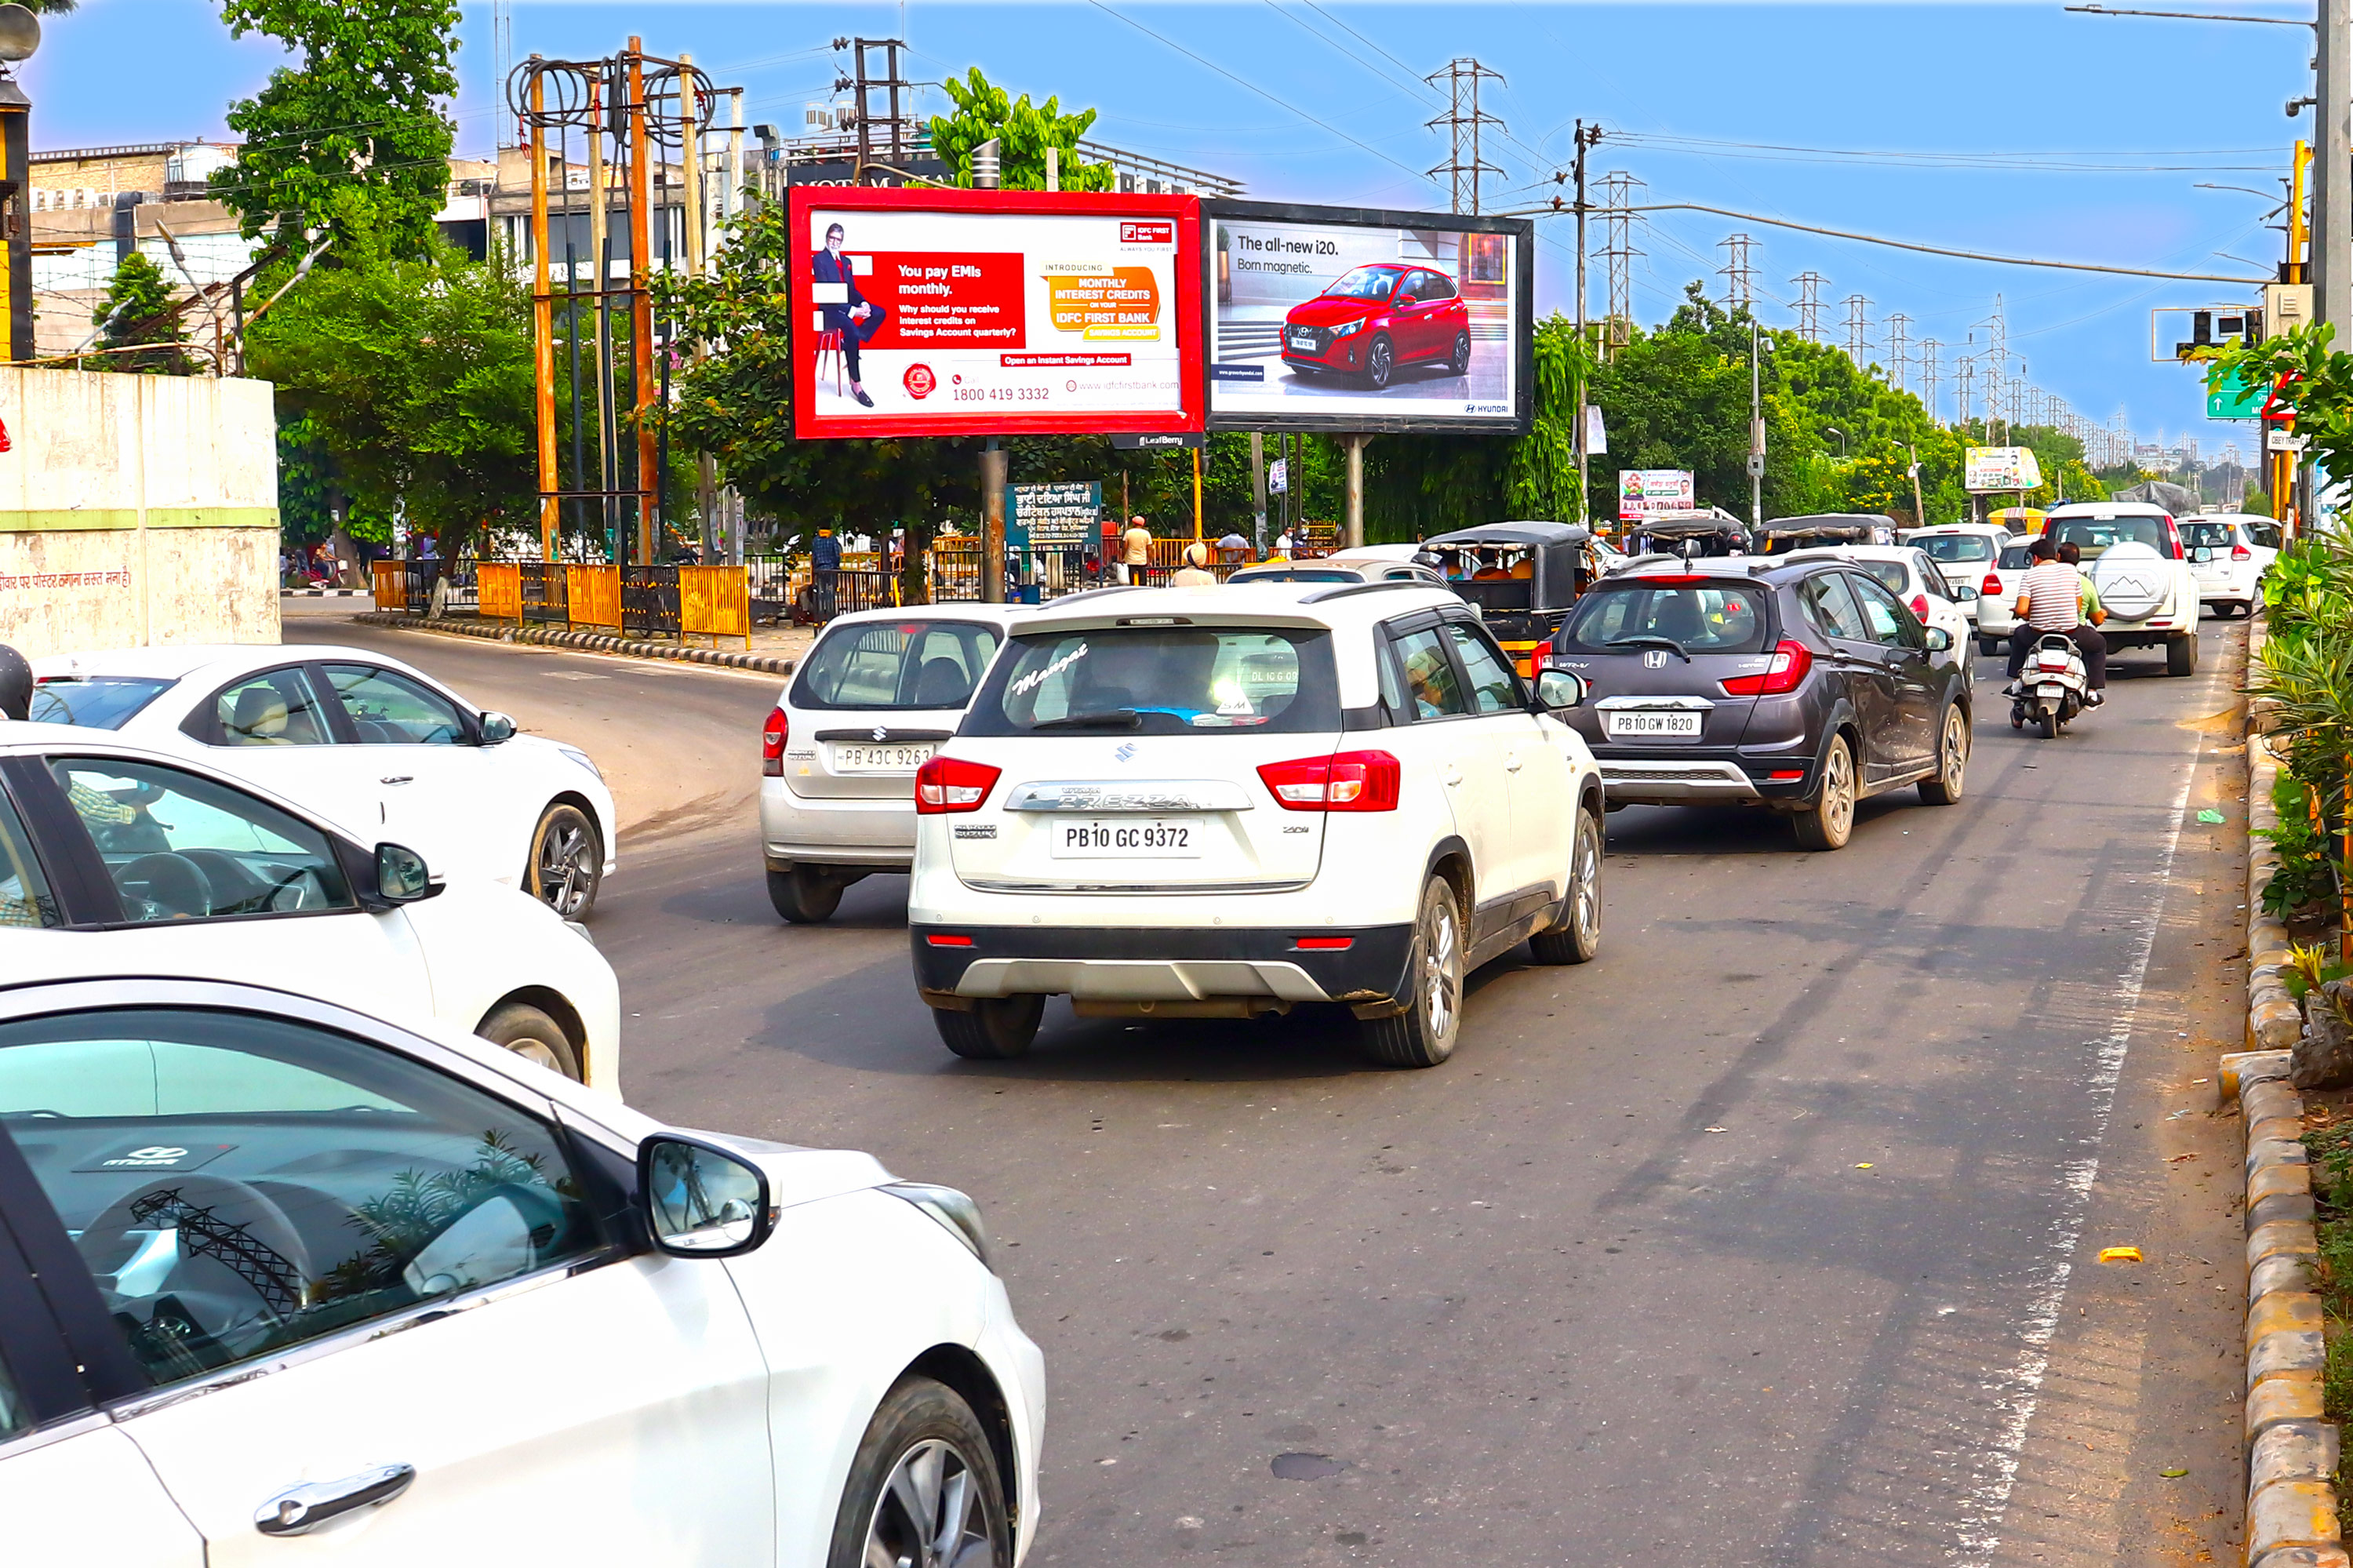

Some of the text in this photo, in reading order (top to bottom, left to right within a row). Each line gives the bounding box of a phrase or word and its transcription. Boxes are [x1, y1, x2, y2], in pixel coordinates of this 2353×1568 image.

[1238, 236, 1338, 255] The all-new i20.
[1238, 258, 1312, 275] Born magnetic.
[898, 265, 981, 280] You pay EMIs
[1078, 278, 1127, 288] MONTHLY
[899, 282, 952, 297] monthly.
[1055, 290, 1150, 300] INTEREST CREDITS
[899, 305, 918, 315] Why
[934, 317, 963, 325] credits
[1056, 313, 1150, 323] IDFC FIRST BANK
[900, 328, 934, 338] Savings
[973, 328, 1016, 338] quarterly?
[1005, 357, 1025, 365] Open
[1065, 356, 1095, 365] Savings
[954, 388, 1049, 401] 1800 419 3332
[1146, 436, 1183, 446] LeafBerry
[2272, 436, 2285, 445] OBEY
[19, 576, 31, 589] पर
[33, 571, 58, 588] पोस्टर
[1252, 672, 1263, 681] DL
[1648, 719, 1663, 730] GW
[1667, 718, 1693, 731] 1820
[846, 750, 929, 765] PB 43C 9263
[1058, 794, 1192, 809] BREZZA
[1116, 828, 1139, 847] GC
[1144, 828, 1188, 847] 9372
